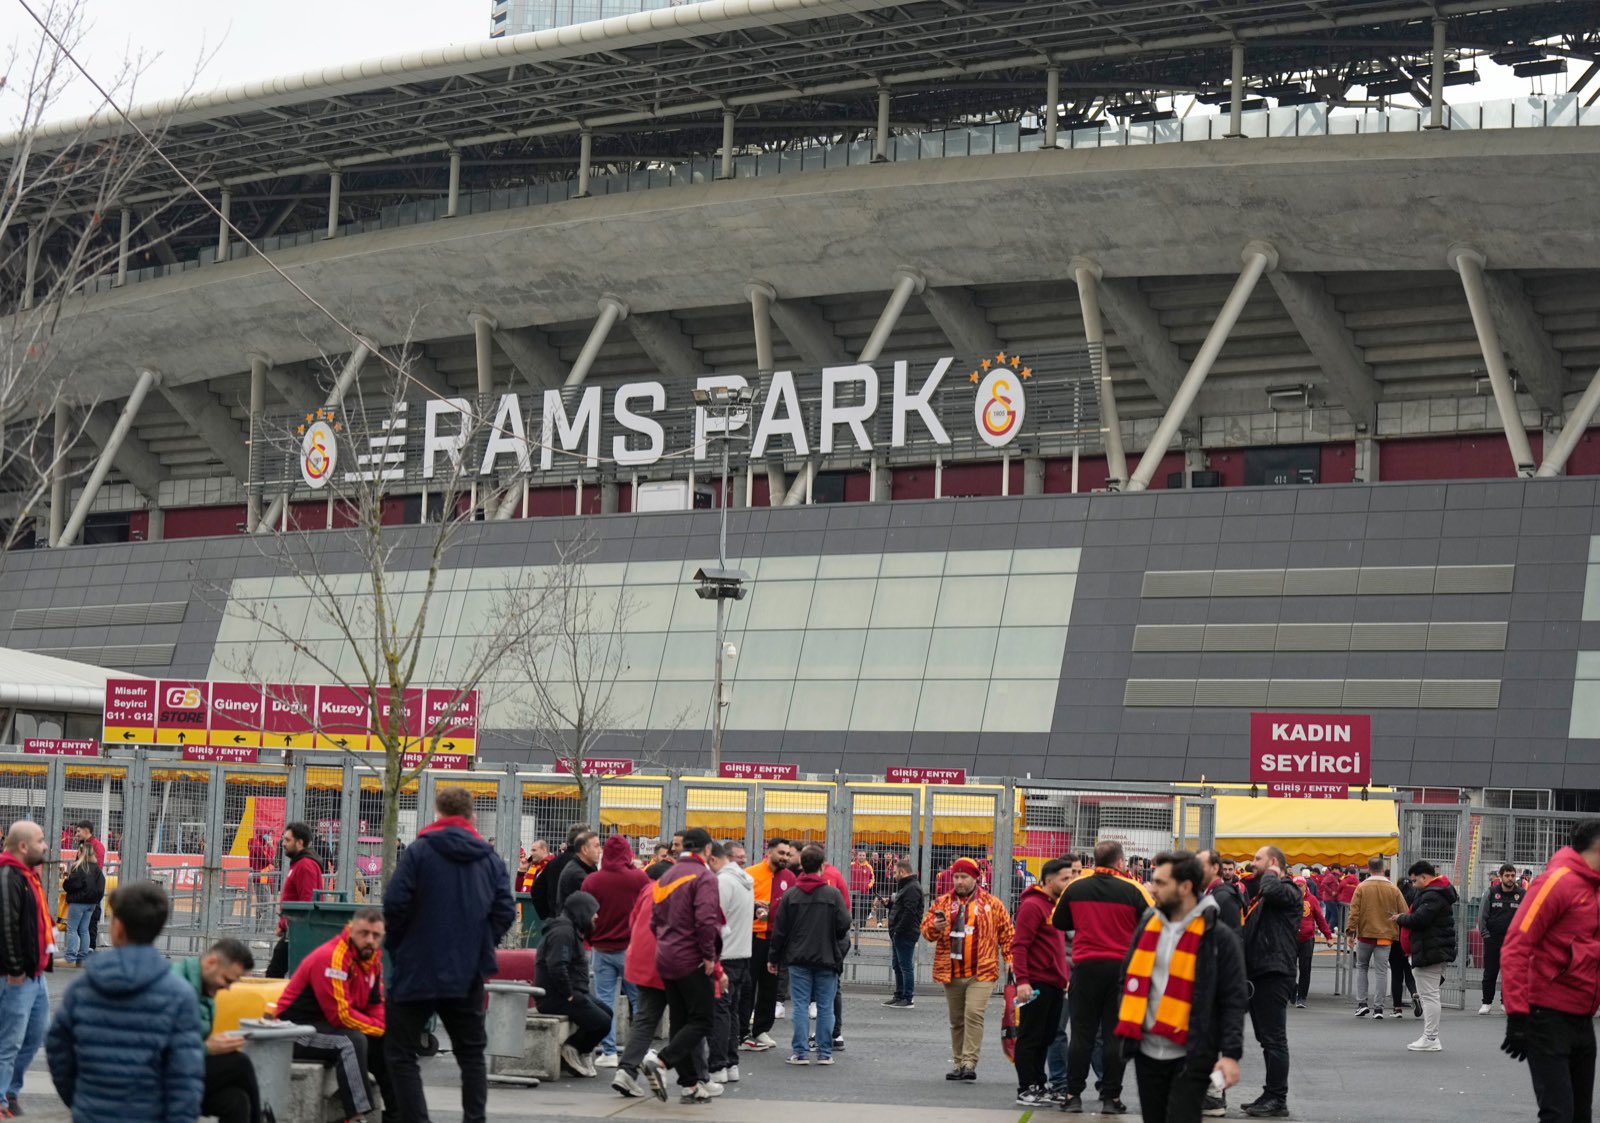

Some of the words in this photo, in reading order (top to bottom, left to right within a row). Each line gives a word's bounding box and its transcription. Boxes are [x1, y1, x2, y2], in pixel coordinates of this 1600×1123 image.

[423, 381, 666, 478] RAMS
[694, 356, 954, 460] PARK
[115, 687, 147, 696] Misafir
[168, 690, 200, 707] GS
[114, 699, 147, 709] Seyirci
[214, 699, 258, 713] Güney
[321, 702, 364, 717] Kuzey
[106, 712, 125, 720] G11
[133, 712, 153, 721] G12
[160, 711, 205, 724] STORE
[1272, 723, 1351, 742] KADIN
[62, 742, 92, 750] ENTRY
[430, 755, 462, 763] ENTRY
[1260, 751, 1360, 774] SEYİRCİ
[594, 761, 625, 769] ENTRY
[759, 766, 792, 774] ENTRY
[1309, 785, 1342, 793] ENTRY
